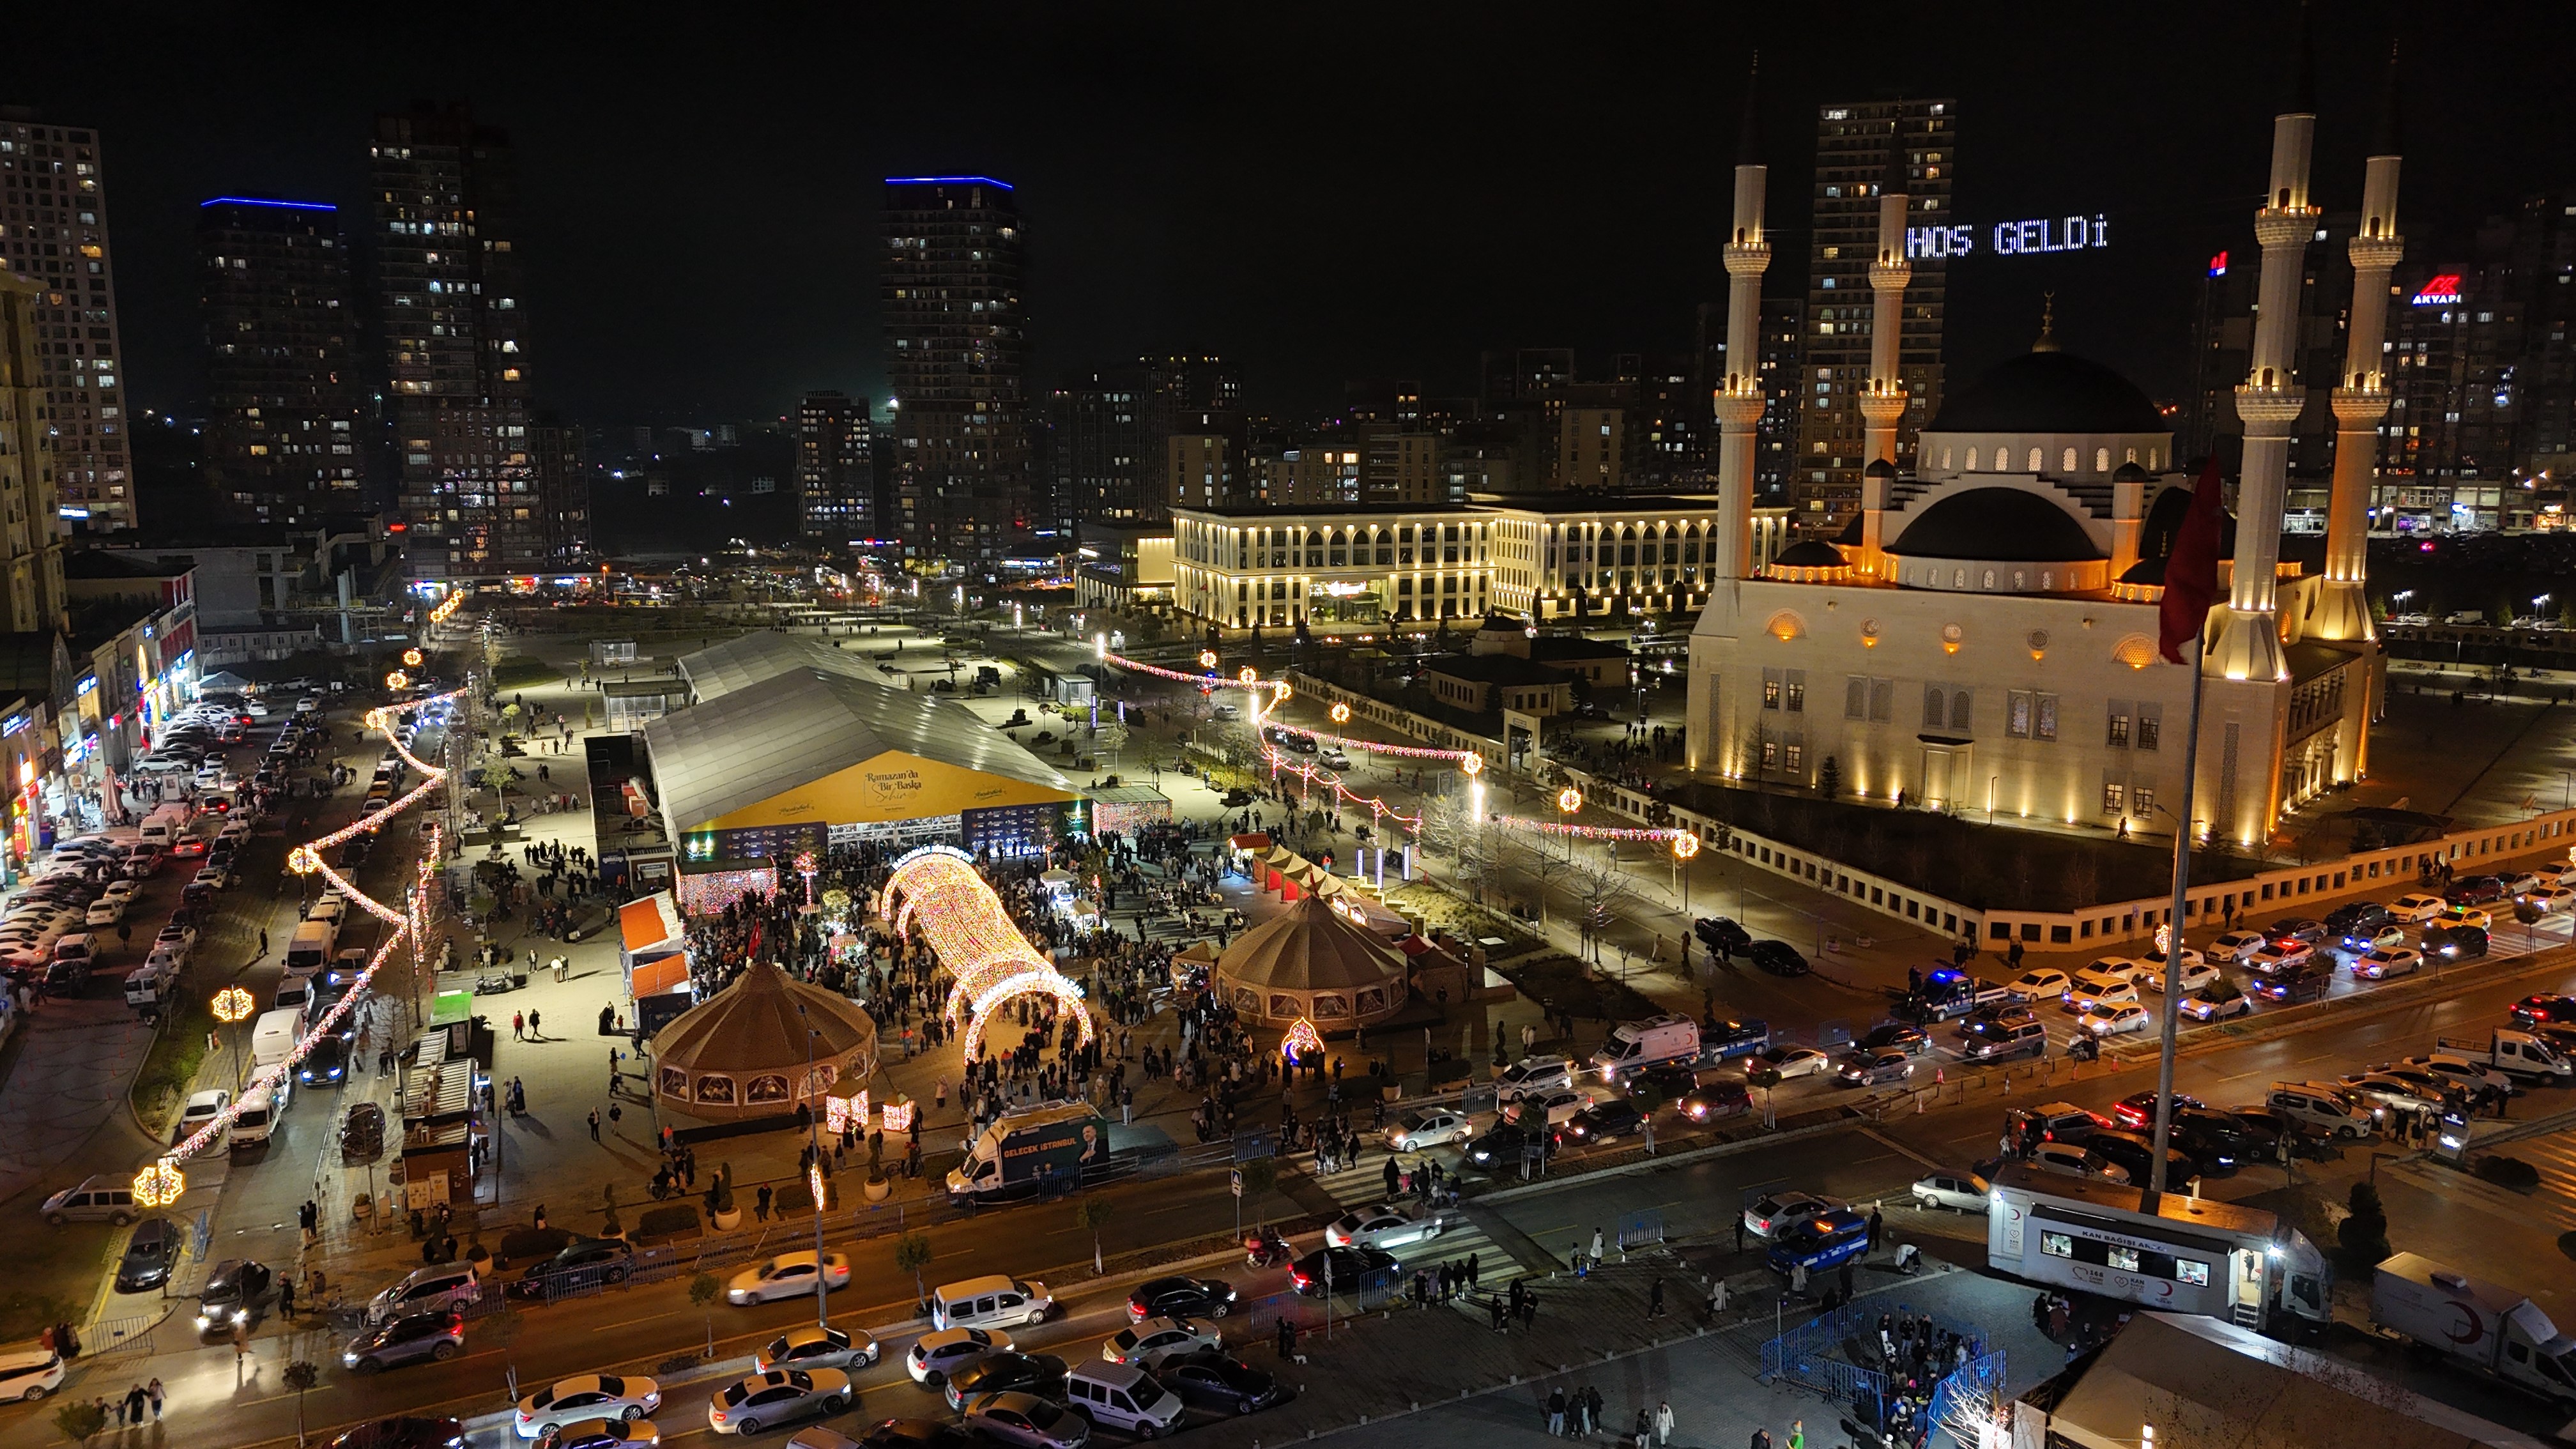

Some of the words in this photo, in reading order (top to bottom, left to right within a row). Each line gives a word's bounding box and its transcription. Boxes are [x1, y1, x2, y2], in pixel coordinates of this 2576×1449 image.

[2412, 295, 2462, 305] AKYAPI
[878, 781, 893, 791] Bir
[1004, 1144, 1039, 1158] GELECEK
[2082, 1230, 2101, 1239] KAN
